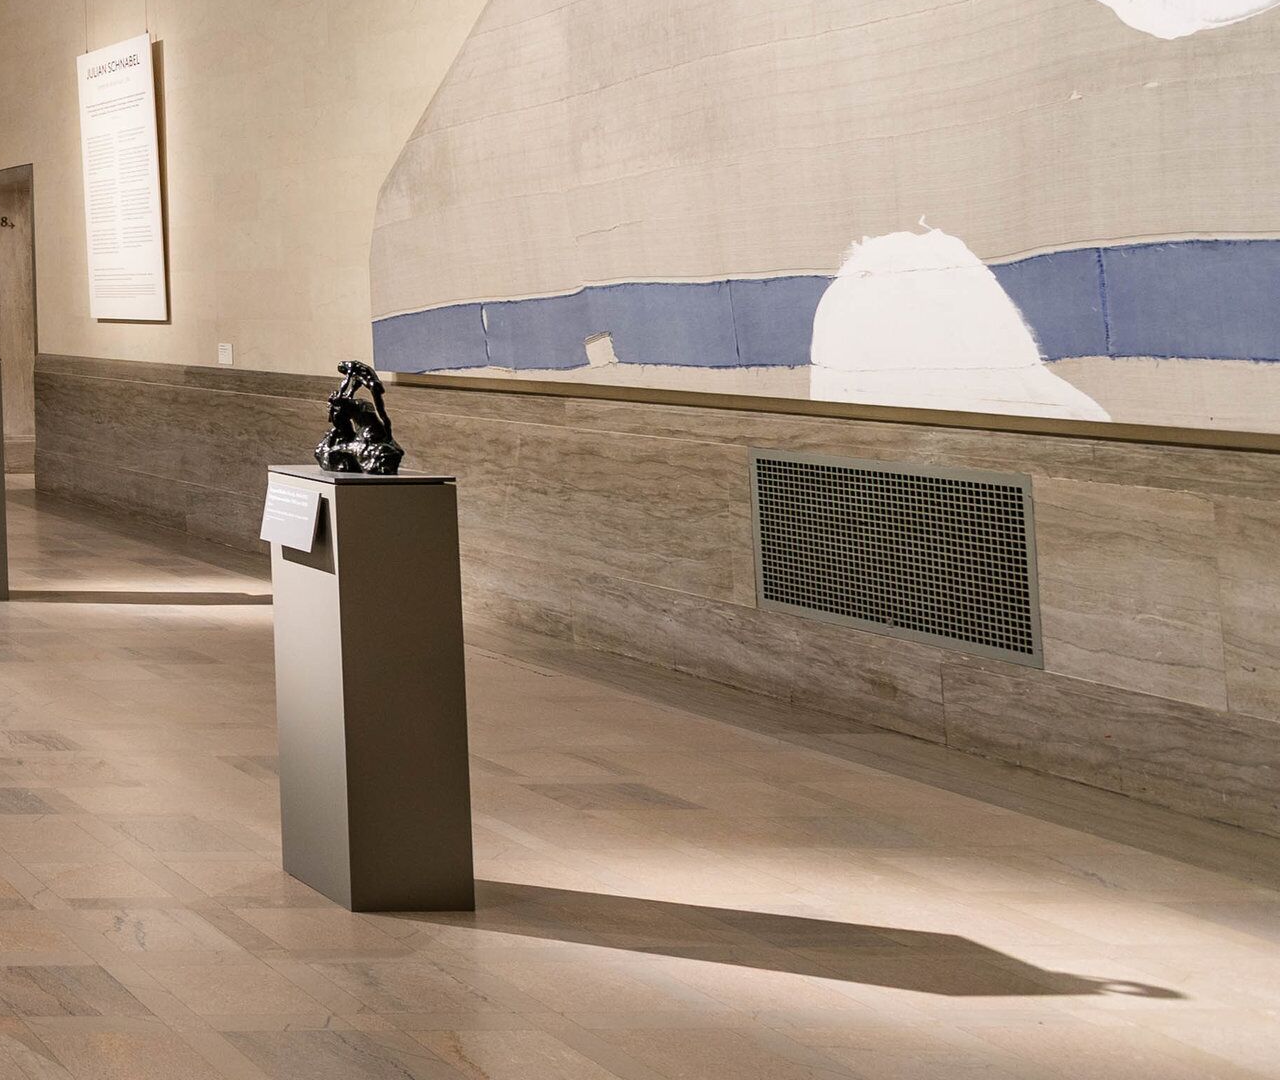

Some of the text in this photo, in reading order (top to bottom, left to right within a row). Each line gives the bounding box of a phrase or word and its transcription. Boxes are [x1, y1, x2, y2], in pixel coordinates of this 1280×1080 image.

[86, 54, 140, 80] JULIAN SCHNABEL
[0, 216, 8, 228] 8
